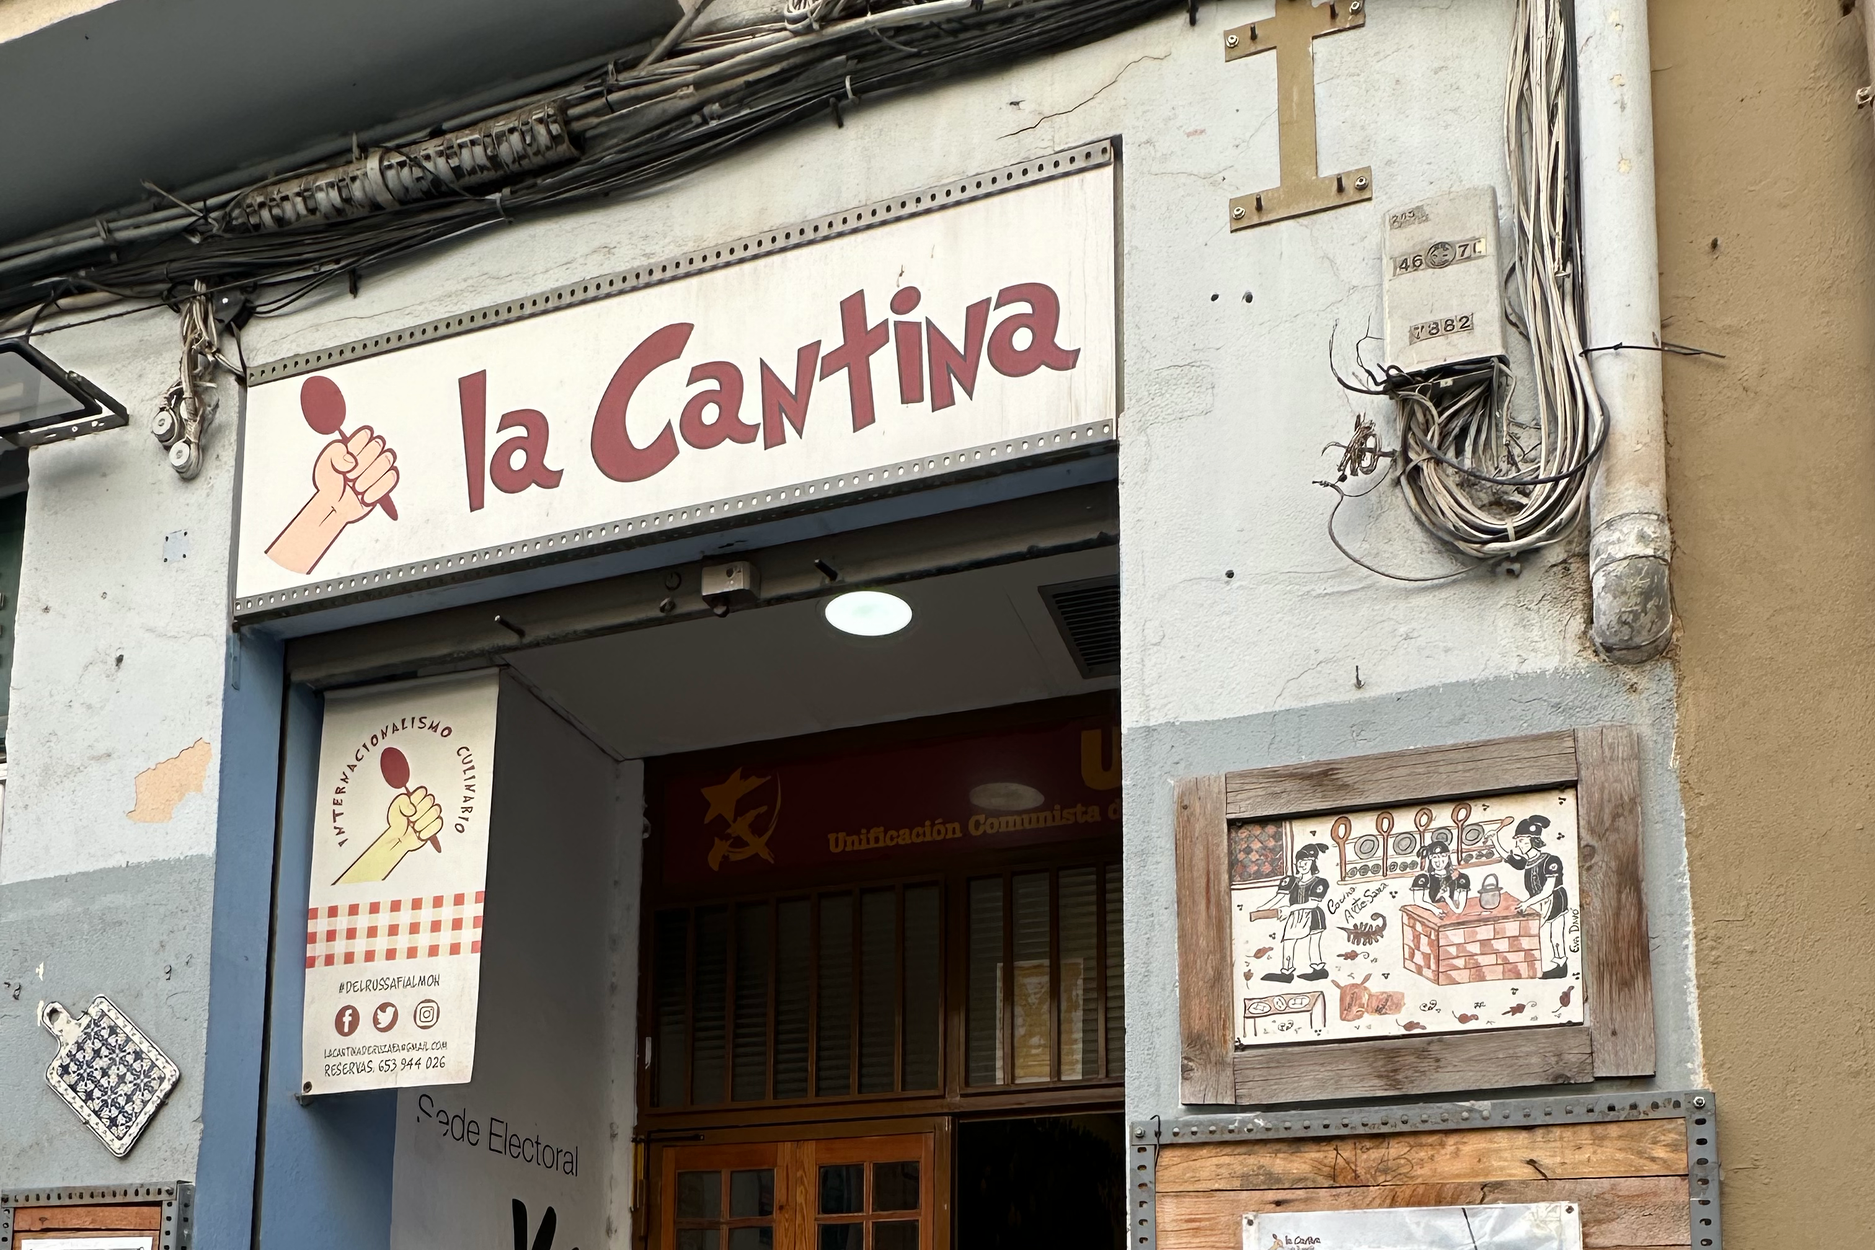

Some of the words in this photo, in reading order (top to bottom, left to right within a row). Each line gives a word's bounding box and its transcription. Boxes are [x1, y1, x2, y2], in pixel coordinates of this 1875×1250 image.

[458, 369, 564, 511] la
[590, 281, 1082, 483] Cantina
[332, 716, 453, 848] INTERNACIONALISMO
[454, 746, 476, 834] CULINARIO
[827, 818, 963, 854] Unificación
[968, 801, 1102, 837] Comunista
[378, 1058, 398, 1073] 653
[400, 1056, 422, 1072] 944
[425, 1055, 446, 1070] 026
[416, 1093, 480, 1146] Sede
[489, 1116, 579, 1177] Electoral
